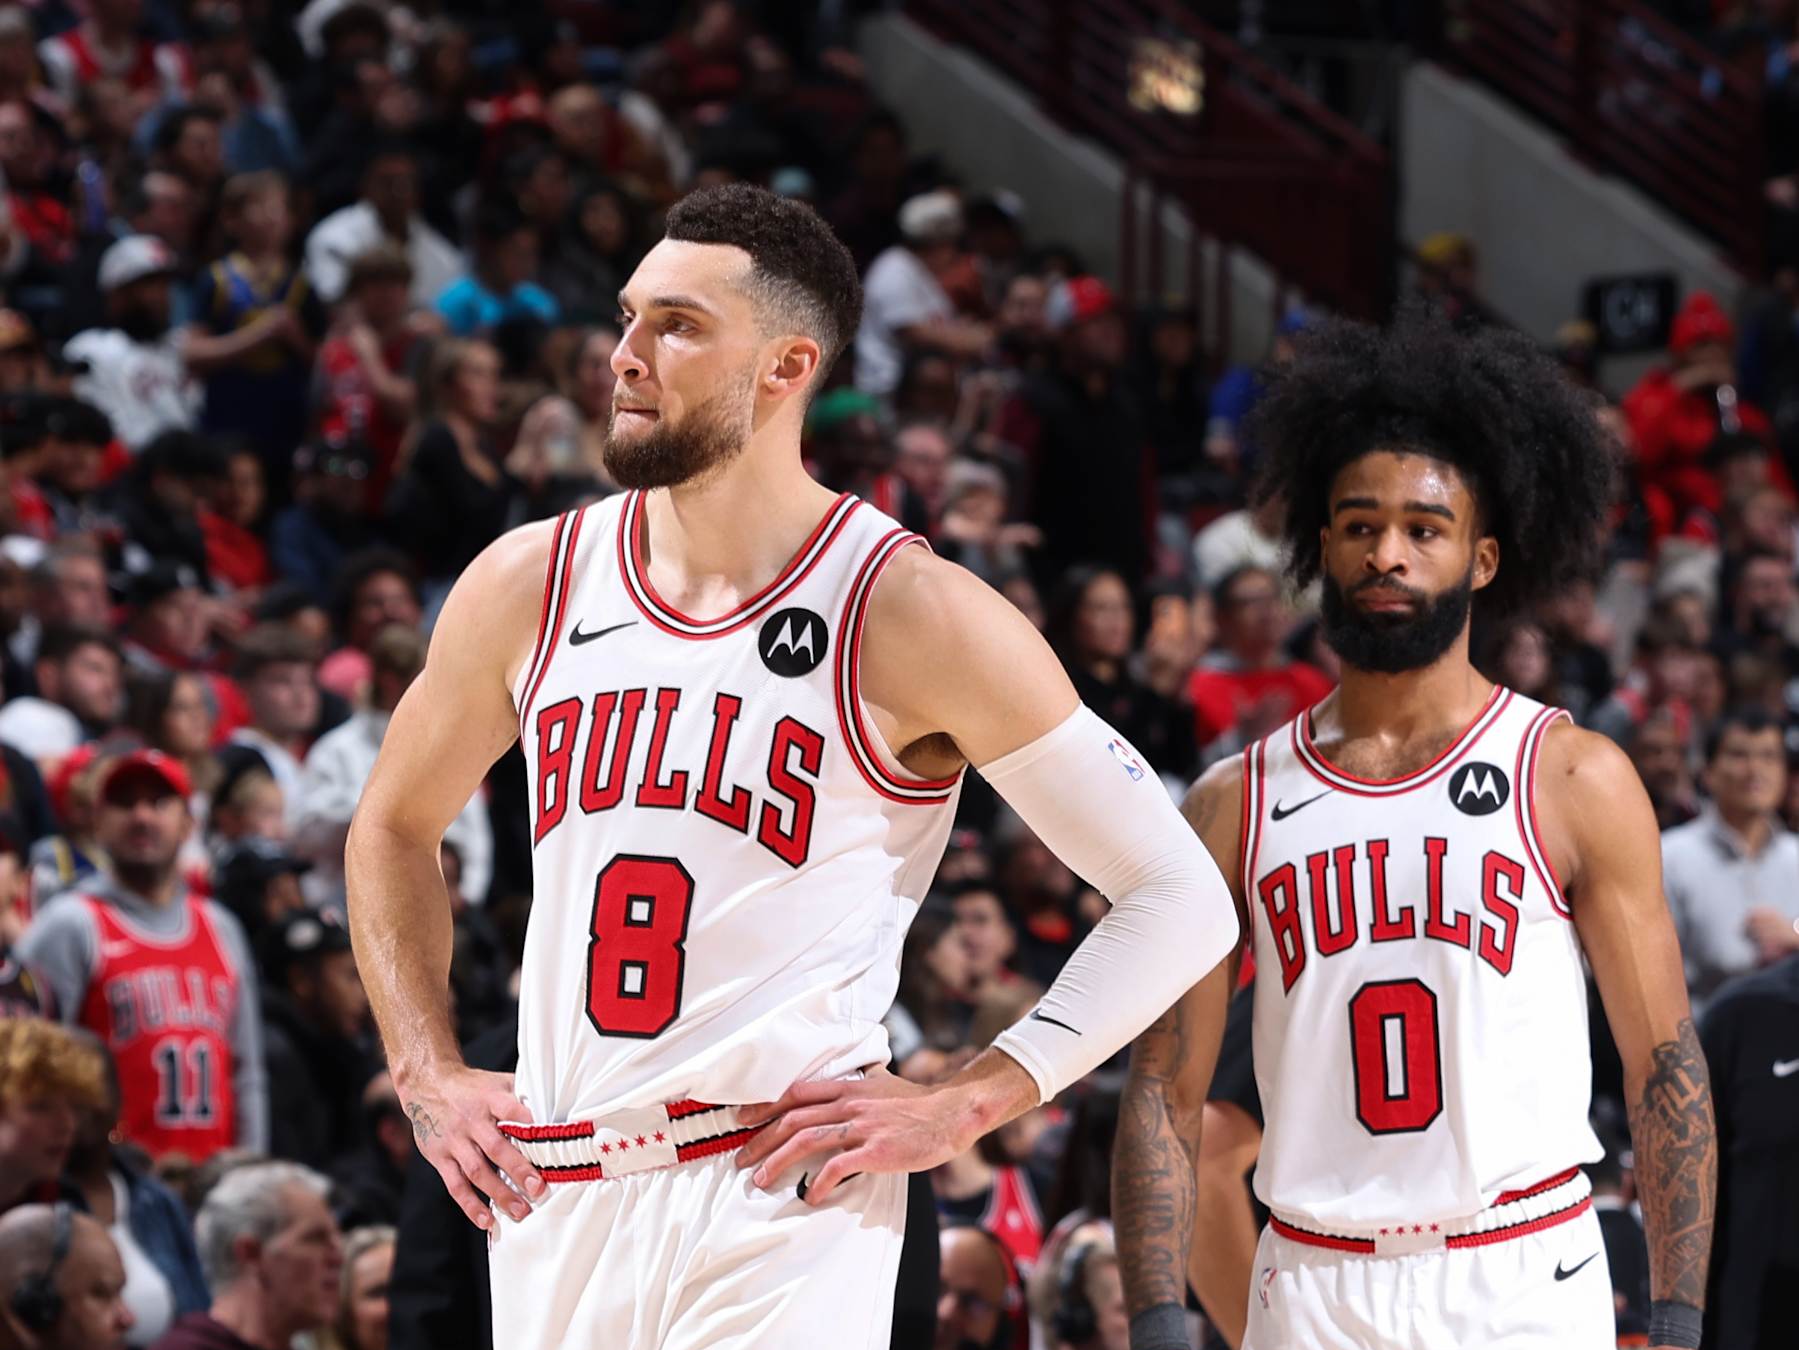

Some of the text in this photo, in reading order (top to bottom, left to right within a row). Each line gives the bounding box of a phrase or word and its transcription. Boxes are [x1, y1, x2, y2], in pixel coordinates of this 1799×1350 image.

[534, 687, 825, 869] BULLS
[585, 853, 695, 1039] 8
[1257, 836, 1525, 998] BULLS
[104, 966, 234, 1047] BULLS
[152, 1038, 217, 1128] 11
[1348, 977, 1443, 1136] 0
